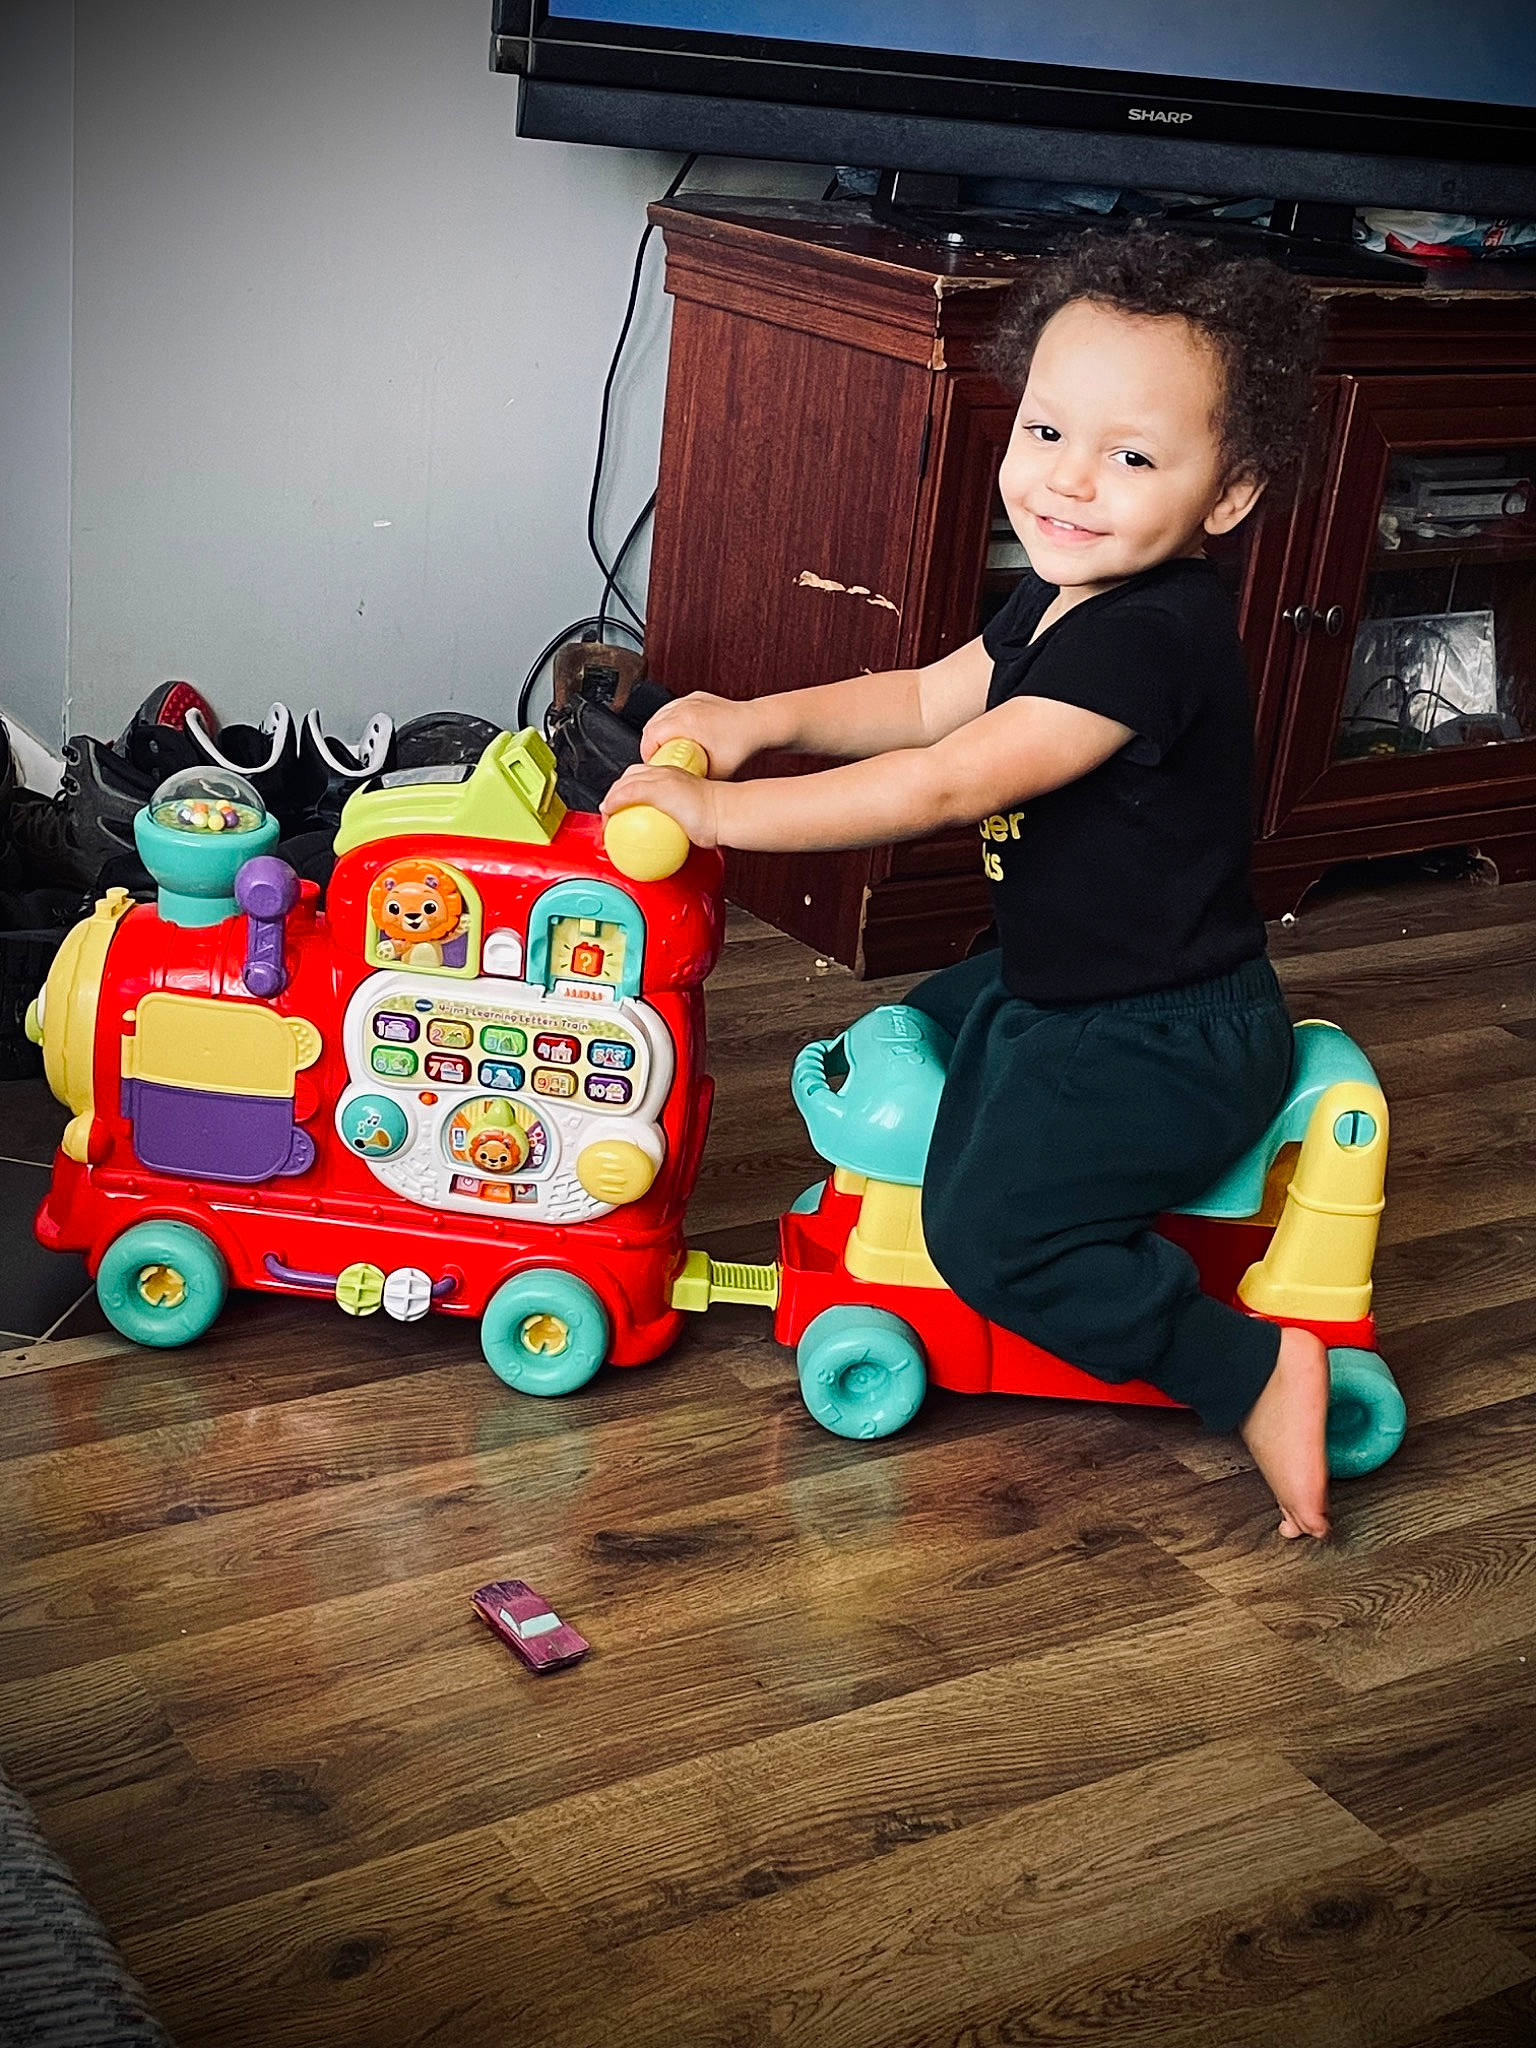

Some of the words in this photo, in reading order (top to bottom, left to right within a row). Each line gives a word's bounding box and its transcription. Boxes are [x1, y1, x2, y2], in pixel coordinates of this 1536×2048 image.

[1128, 108, 1193, 124] SHARP
[472, 1008, 517, 1022] Learning
[519, 1014, 558, 1026] Letters
[561, 1020, 588, 1030] Train
[376, 1020, 385, 1036] 1
[432, 1028, 442, 1041] 2
[428, 1061, 441, 1077] 7
[537, 1078, 547, 1089] 9
[588, 1082, 606, 1098] 10
